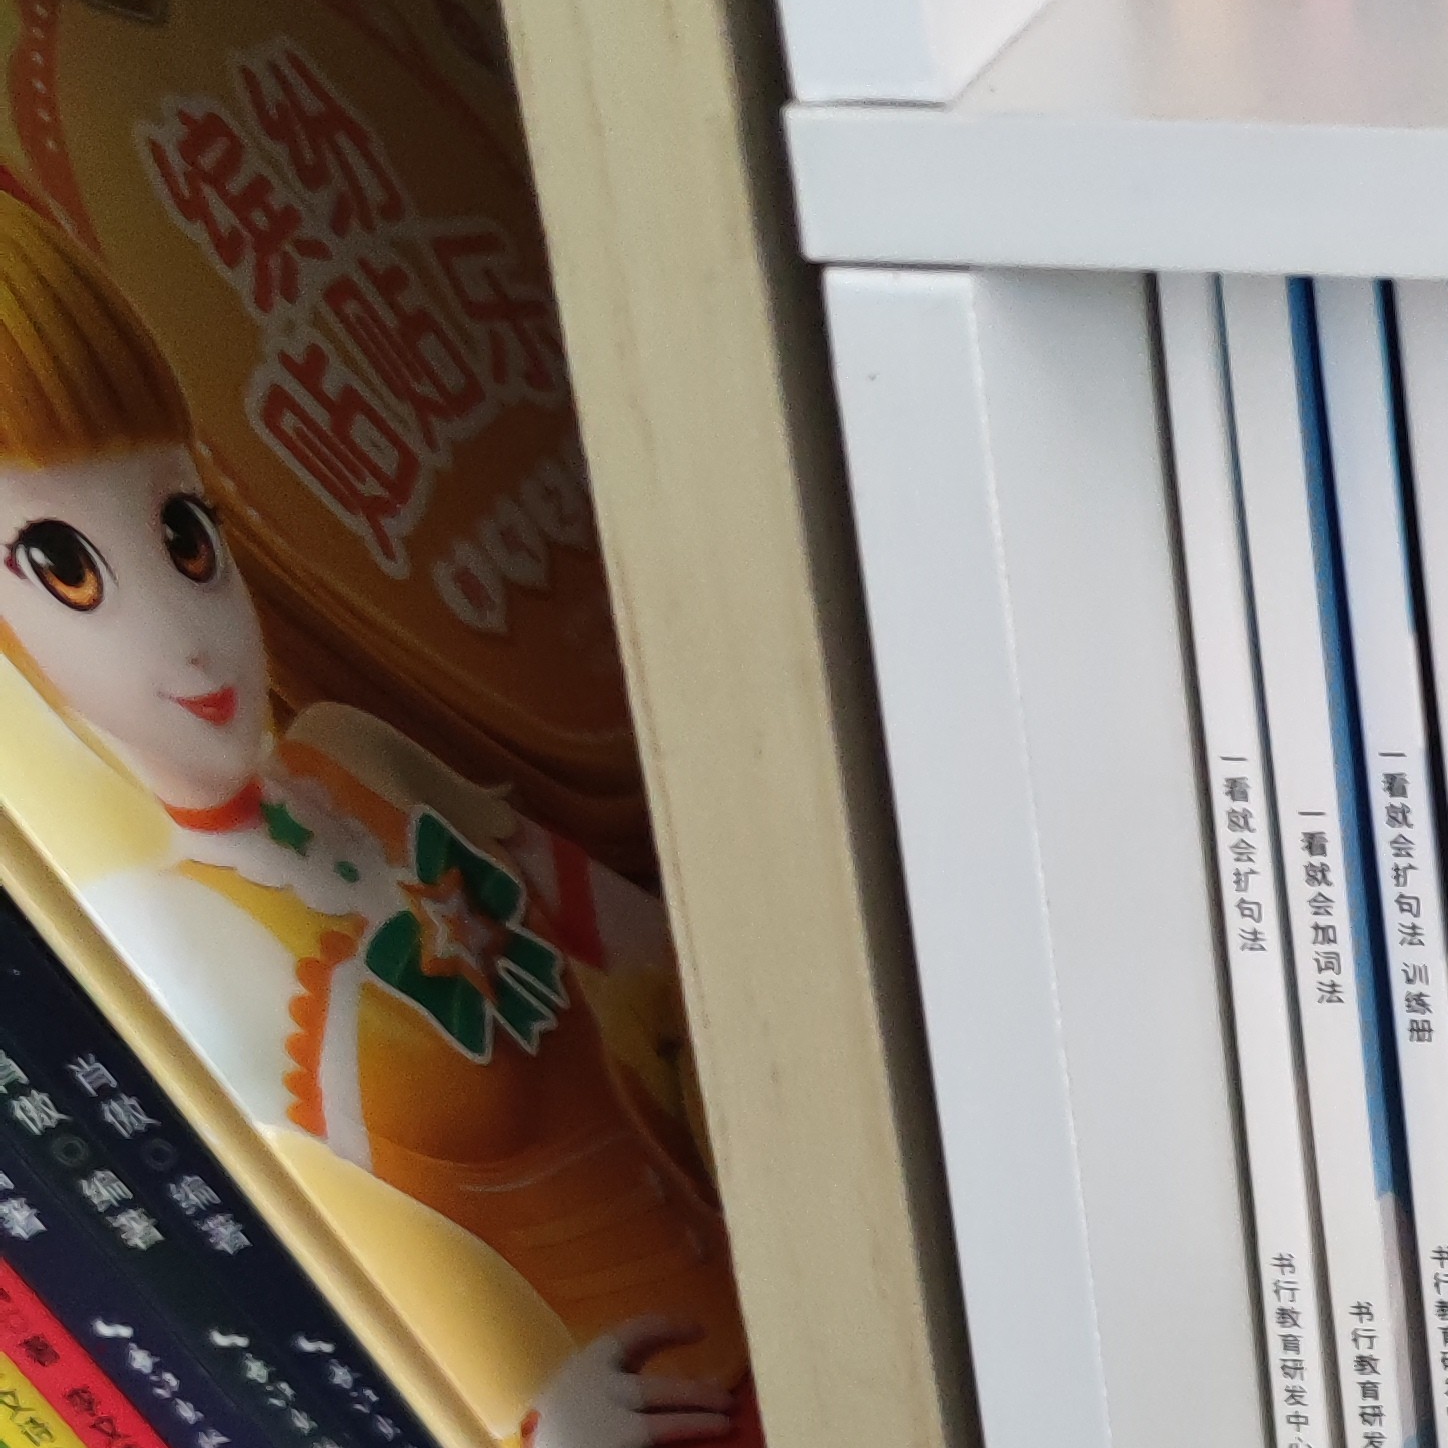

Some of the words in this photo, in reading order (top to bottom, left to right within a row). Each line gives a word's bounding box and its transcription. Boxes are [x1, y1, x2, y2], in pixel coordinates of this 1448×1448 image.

[146, 40, 408, 310] 缤纷
[258, 224, 562, 572] 贴贴乐
[1218, 753, 1269, 955] 一看就会扩句法
[1297, 809, 1346, 1007] 一看就会加词法
[1378, 750, 1426, 949] 一看就会扩句法
[1400, 961, 1435, 1044] 训练册
